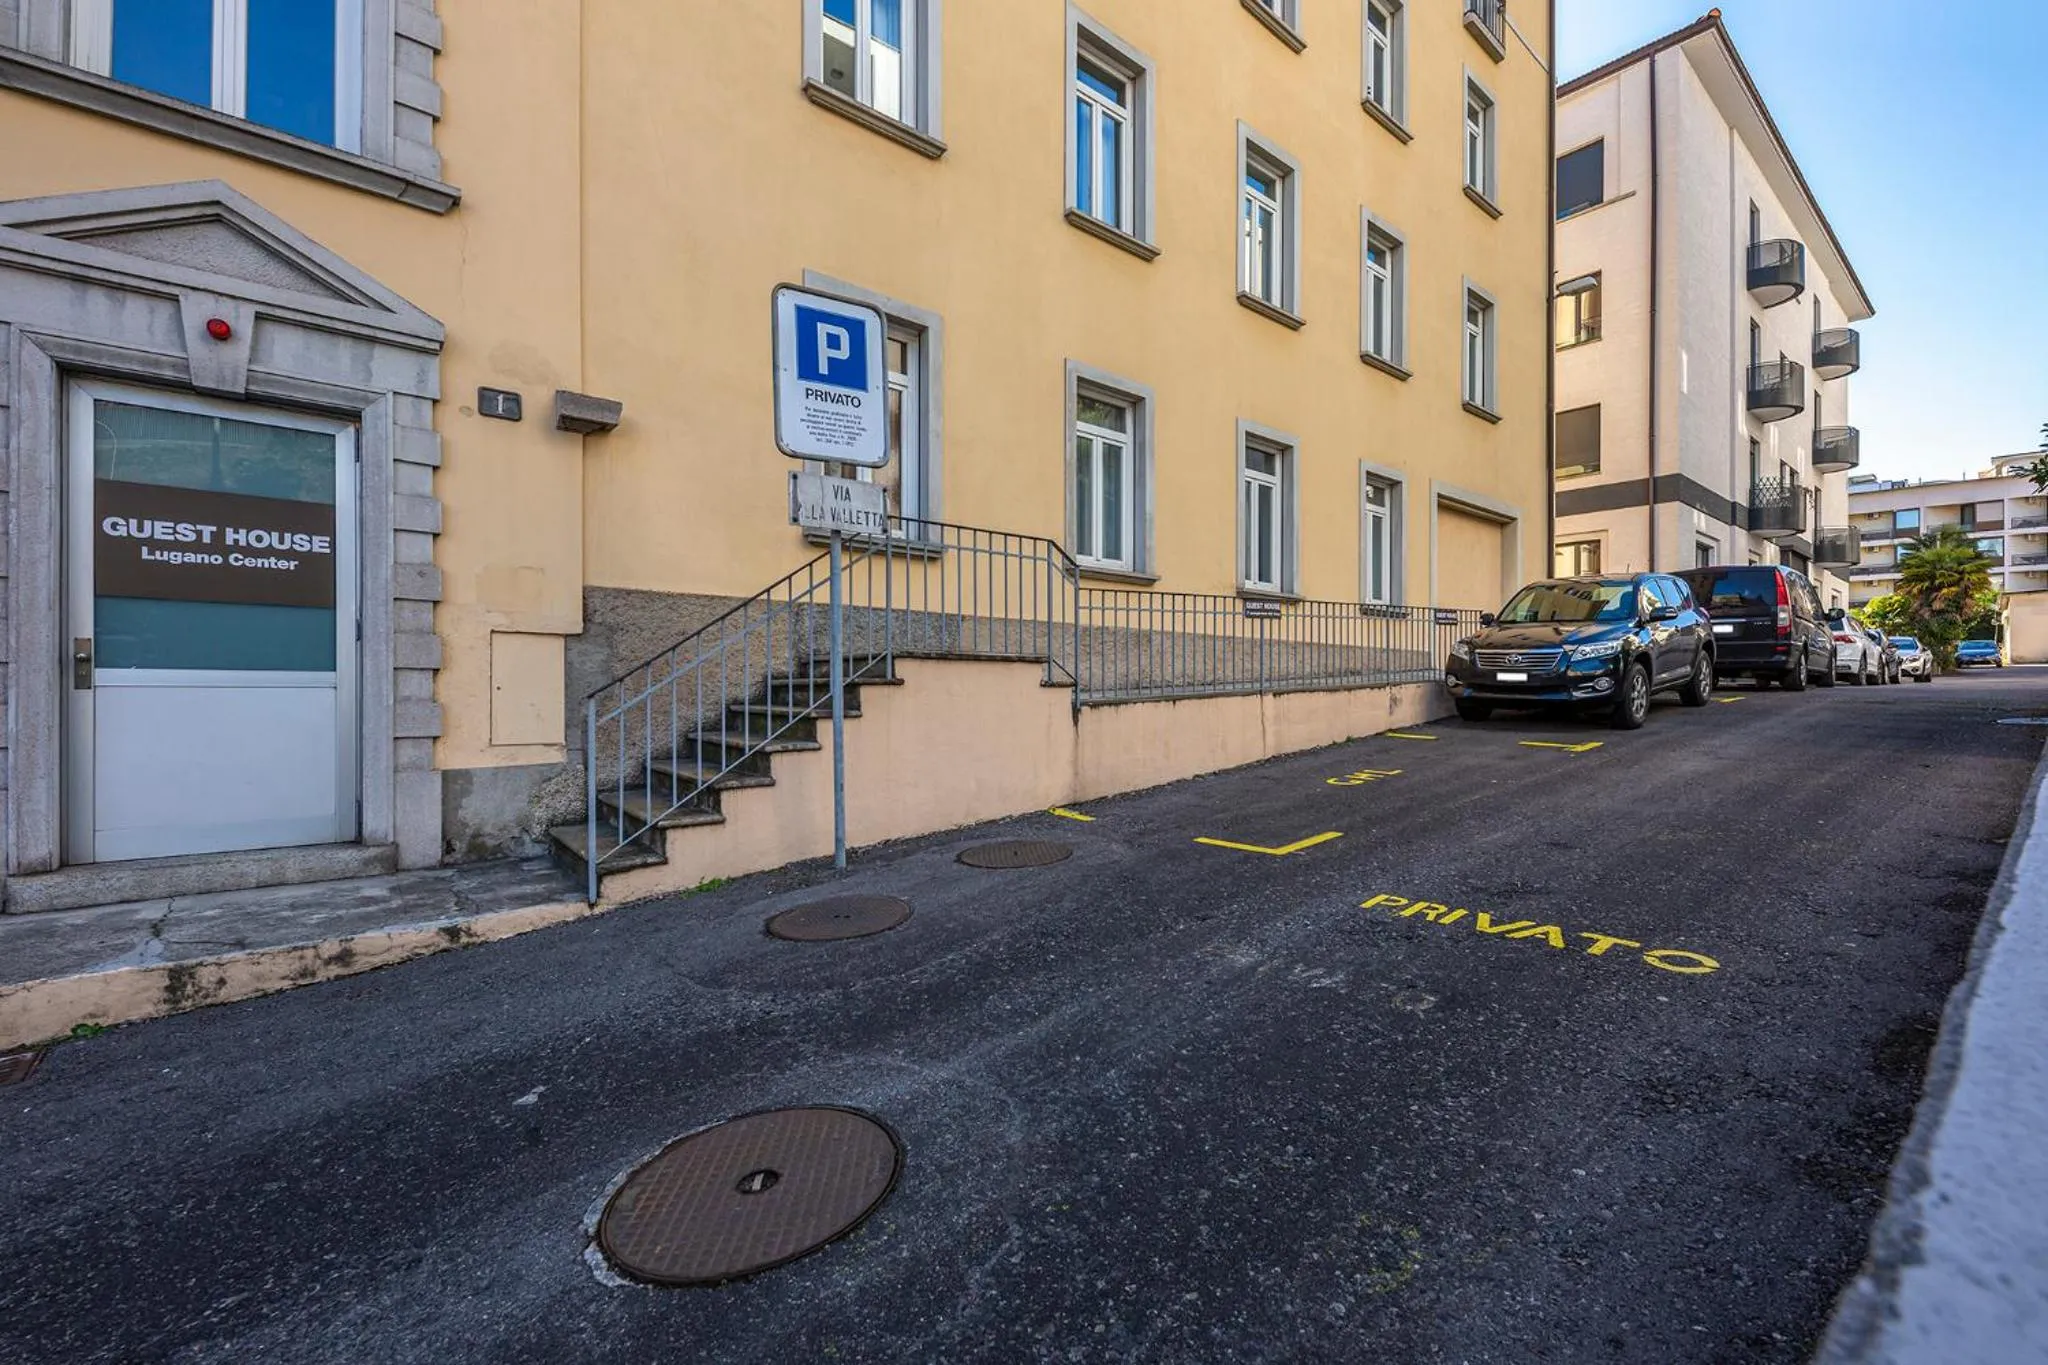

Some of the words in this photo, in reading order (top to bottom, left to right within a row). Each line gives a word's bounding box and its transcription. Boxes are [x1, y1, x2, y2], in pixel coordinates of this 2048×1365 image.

[816, 321, 851, 376] P
[497, 393, 505, 415] 1
[805, 387, 862, 408] PRIVATO
[832, 483, 852, 502] VIA
[102, 516, 217, 544] GUEST
[225, 527, 332, 554] HOUSE
[141, 546, 223, 565] Lugano
[228, 552, 299, 570] Center
[1359, 893, 1721, 975] PRIVATO
